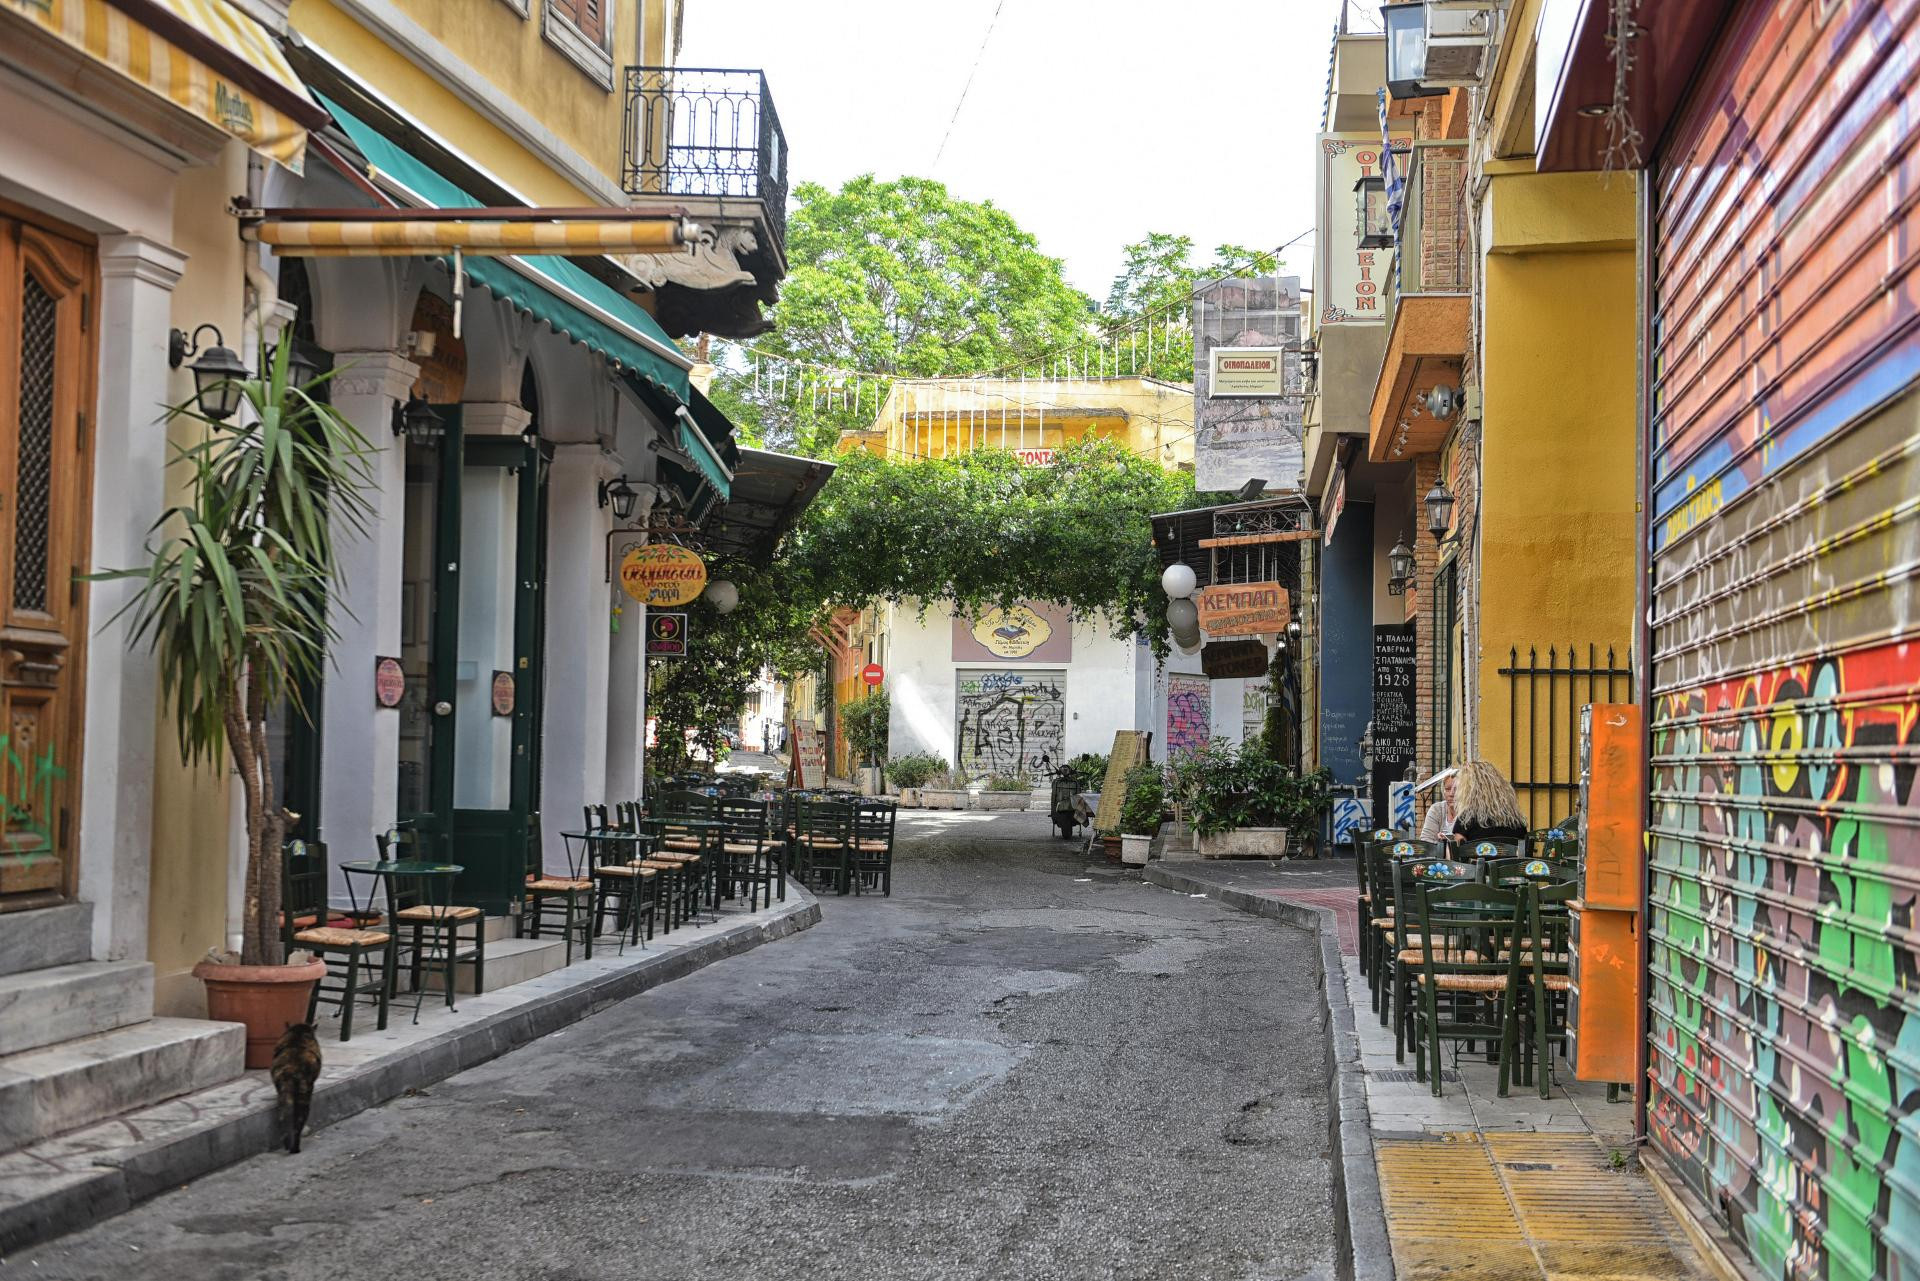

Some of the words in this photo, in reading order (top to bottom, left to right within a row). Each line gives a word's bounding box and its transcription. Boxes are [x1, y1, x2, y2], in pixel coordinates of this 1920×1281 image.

[1203, 590, 1277, 611] ΚΕΜΠΑΠ
[1378, 674, 1410, 686] 1928
[1375, 738, 1391, 746] ΔΙΚΟ
[1395, 738, 1410, 746] ΜΑΣ
[1375, 755, 1399, 763] ΚΡΑΣΙ
